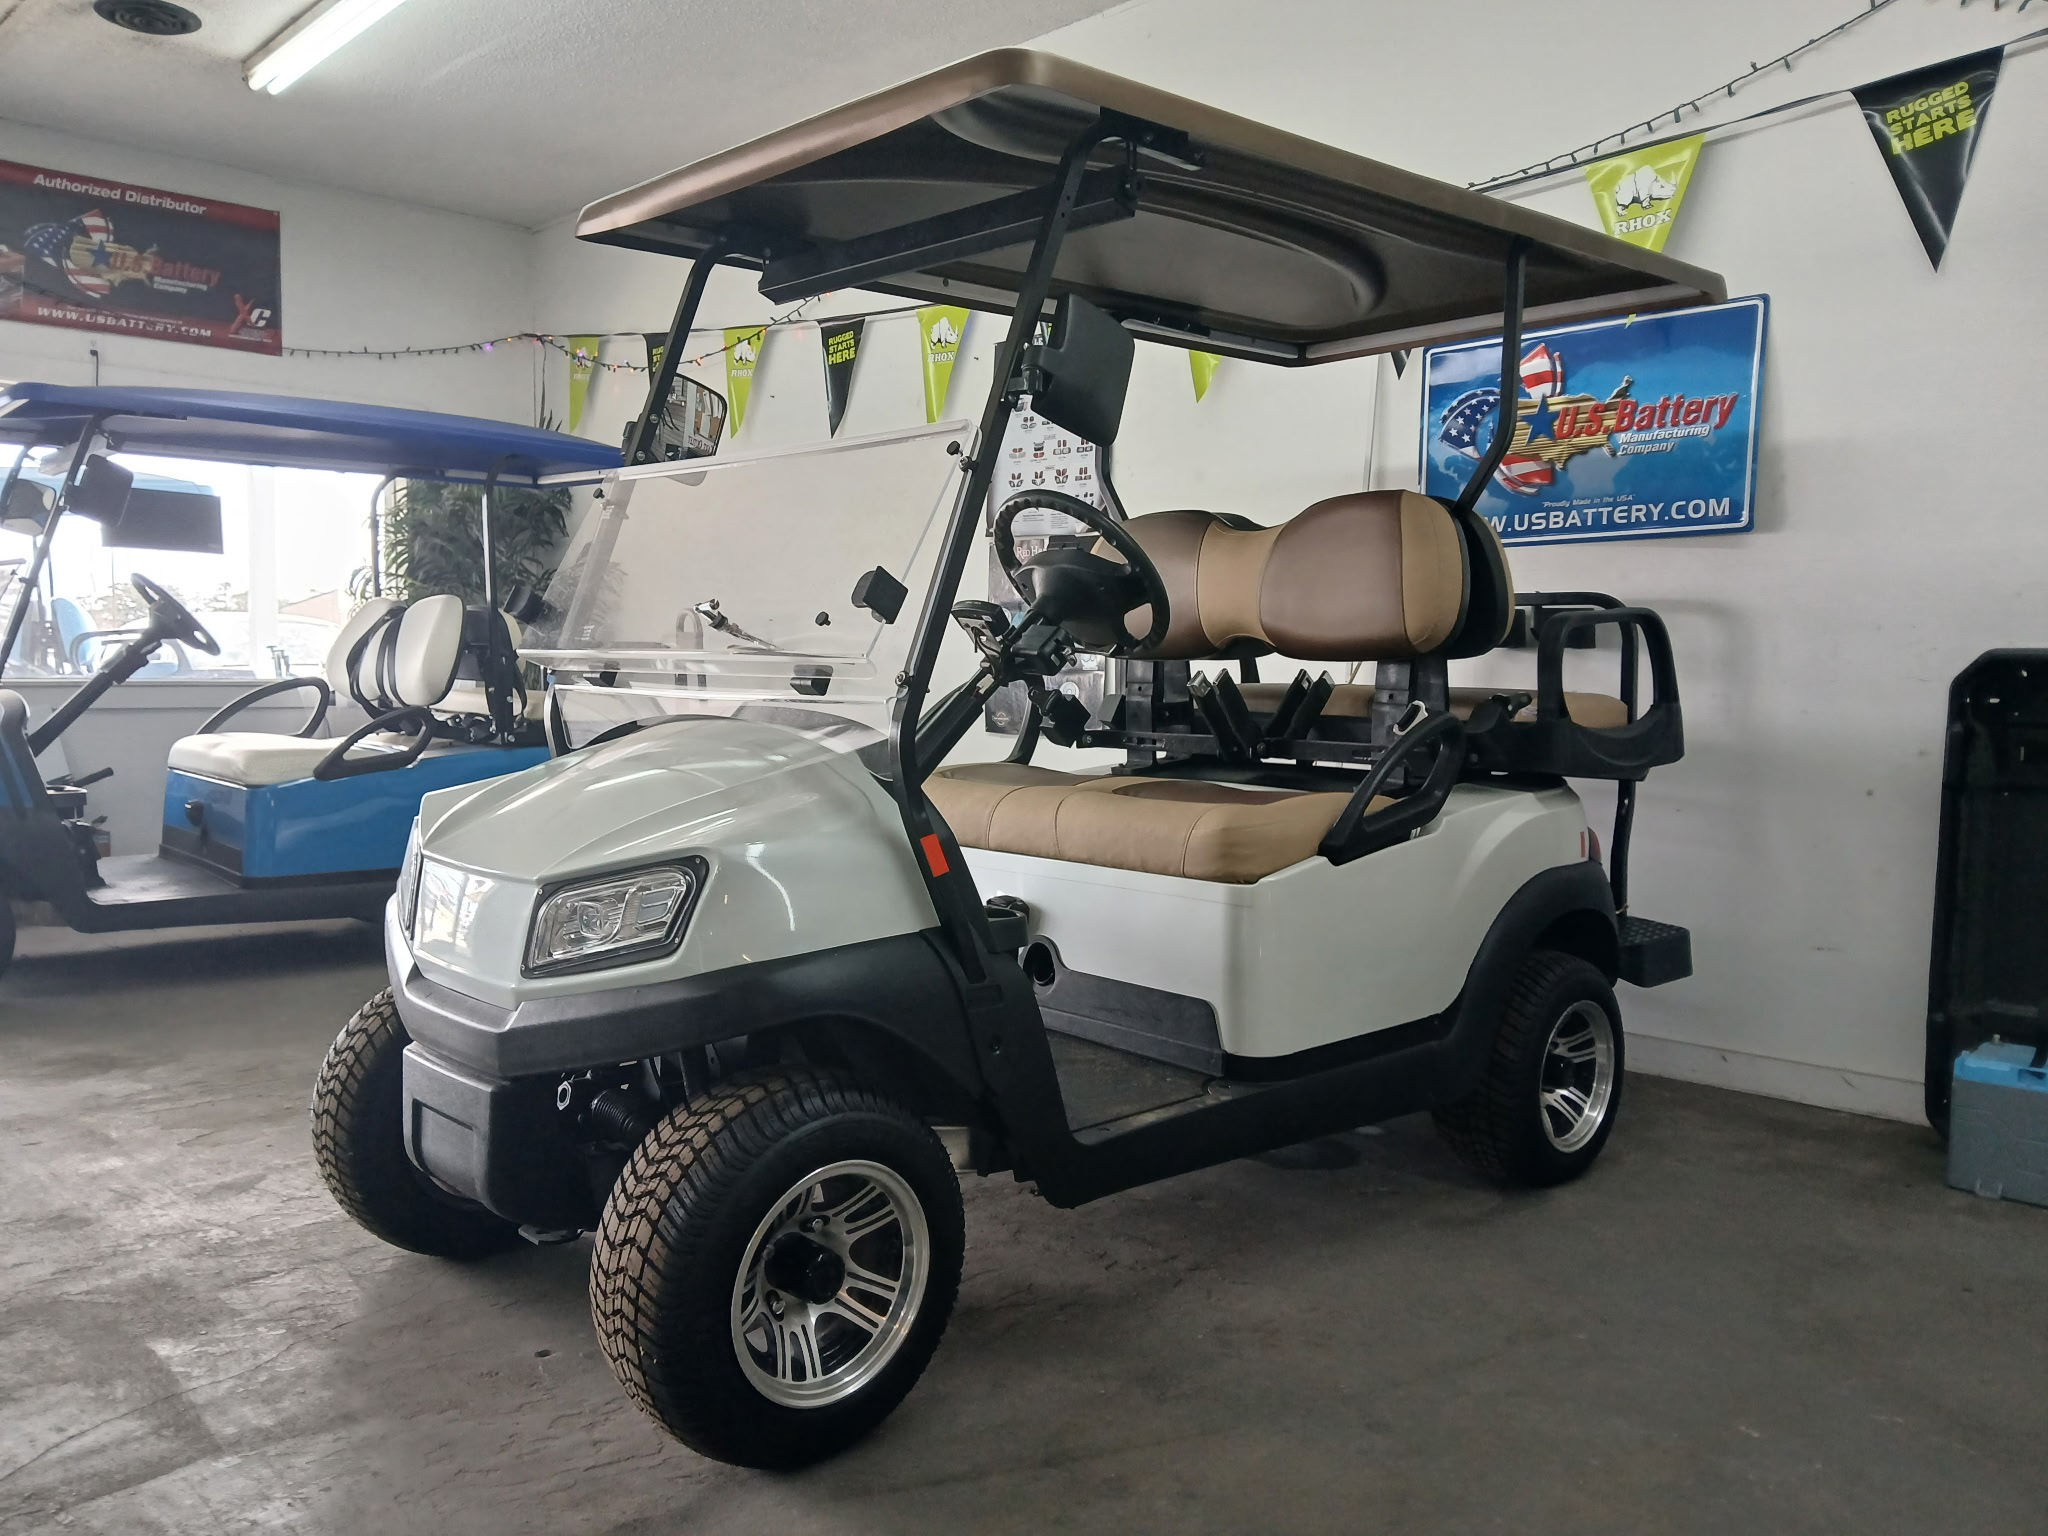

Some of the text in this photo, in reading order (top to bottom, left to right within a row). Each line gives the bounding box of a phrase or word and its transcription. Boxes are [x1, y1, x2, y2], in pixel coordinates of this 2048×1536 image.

[1886, 81, 1969, 124] RUGGED
[1889, 94, 1973, 136] STARTS
[1891, 108, 1977, 155] HERE
[33, 174, 207, 215] Authorized Distributor
[1614, 208, 1672, 237] RHOX
[828, 330, 854, 346] RUGGED
[828, 338, 855, 353] STARTS
[828, 346, 856, 365] HERE
[928, 351, 955, 362] RHOX
[731, 368, 753, 377] RHOX
[1613, 392, 1739, 433] Battery
[1619, 425, 1710, 445] Manufacturing
[1618, 441, 1675, 456] Company
